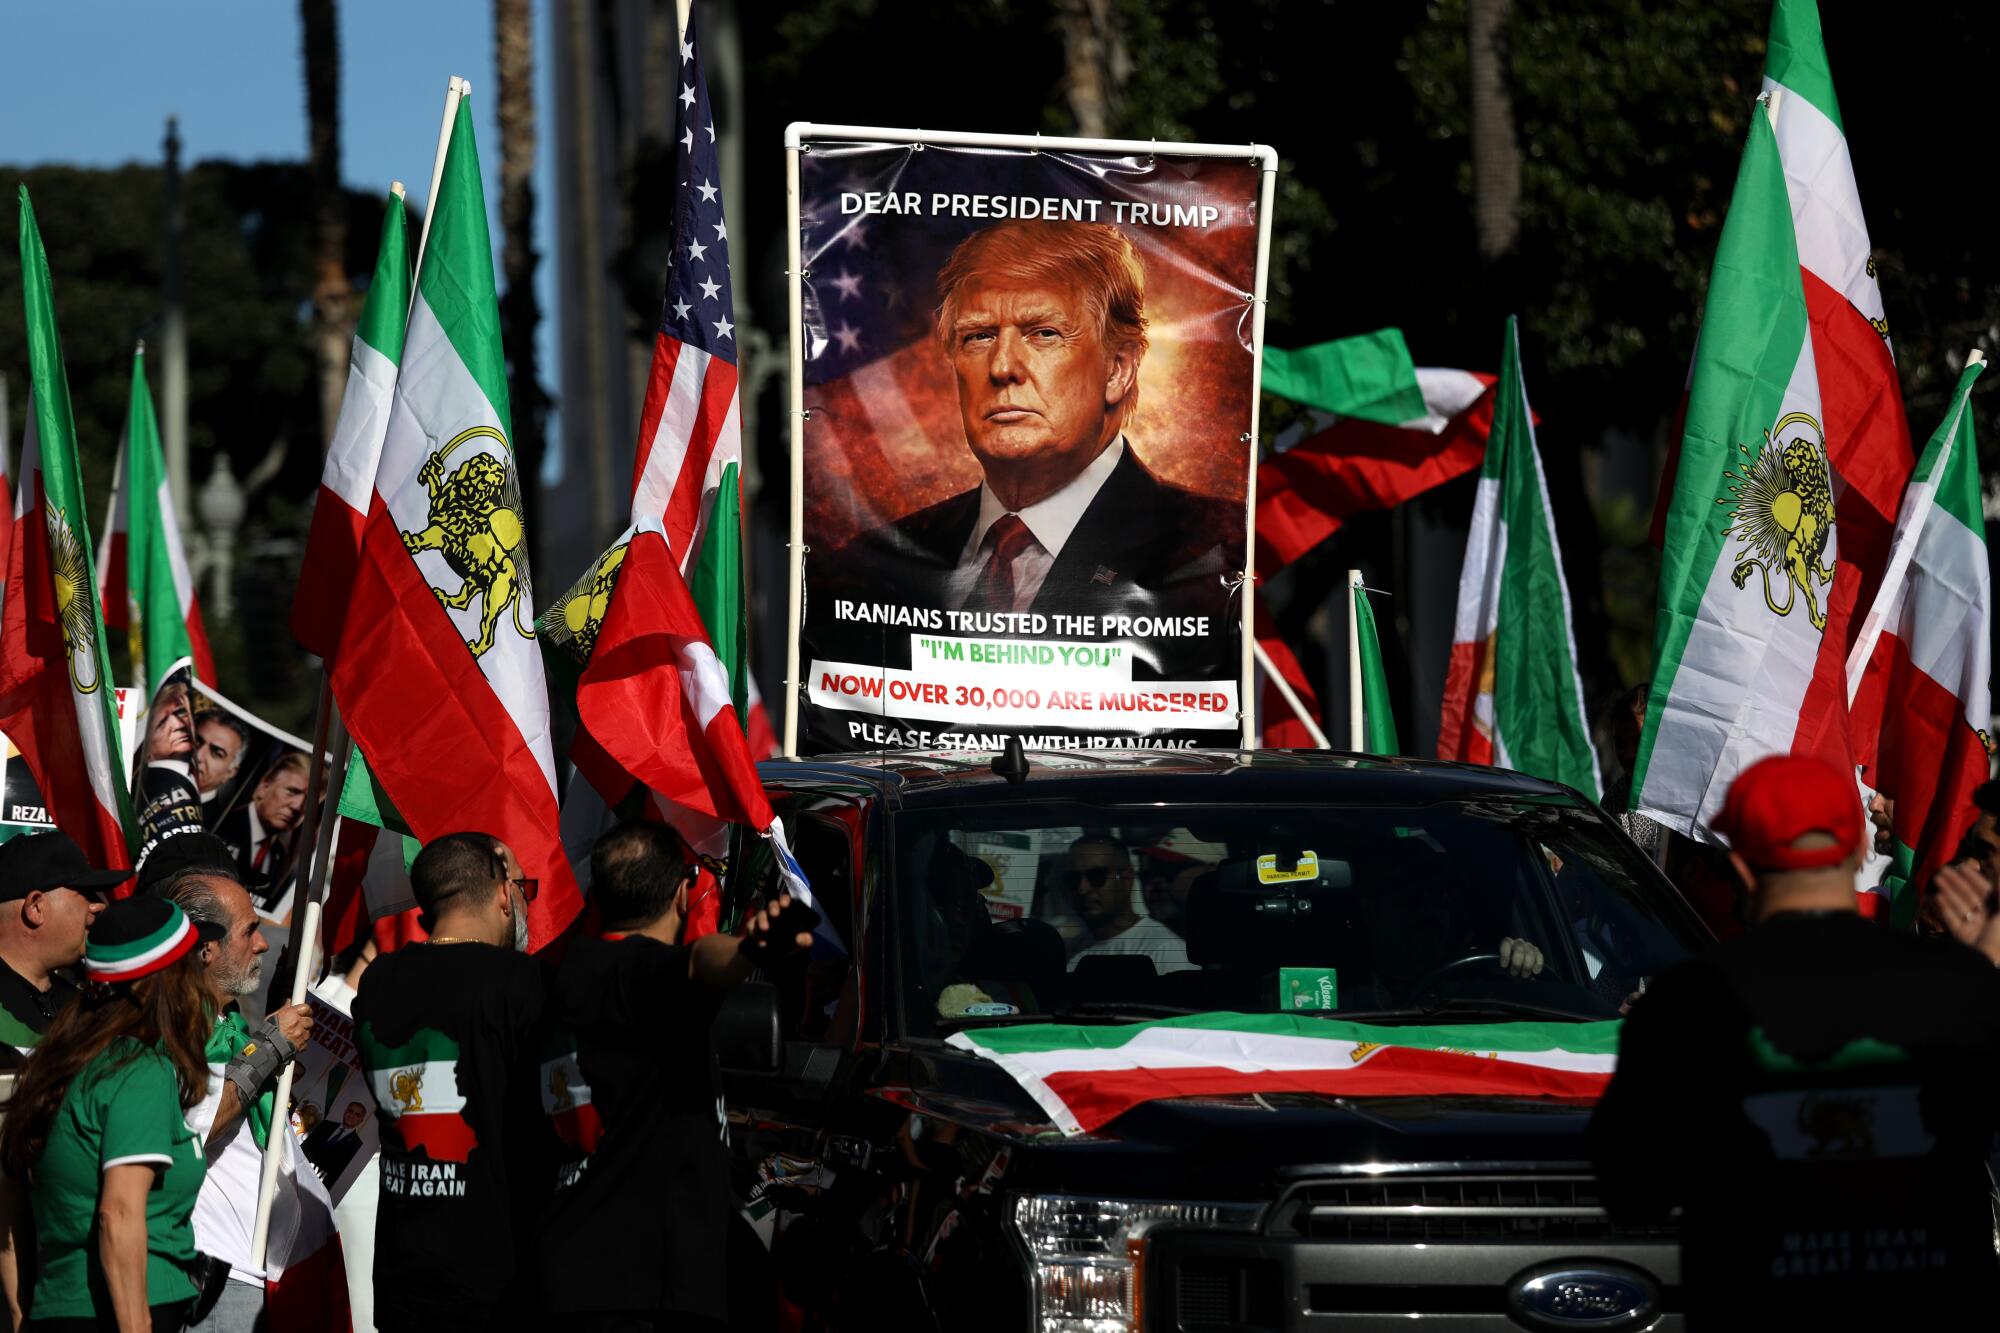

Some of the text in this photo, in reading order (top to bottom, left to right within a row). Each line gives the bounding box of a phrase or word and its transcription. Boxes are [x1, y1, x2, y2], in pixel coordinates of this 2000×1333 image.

[840, 192, 1219, 228] DEAR PRESIDENT TRUMP
[834, 599, 1209, 637] IRANIANS TRUSTED THE PROMISE
[920, 639, 1122, 669] "I'M BEHIND YOU"
[821, 672, 1229, 713] NOW OVER 30,000 ARE MURDERED
[848, 721, 932, 749] PLEASE
[1017, 734, 1080, 750] WITH
[12, 805, 46, 822] REZA
[309, 1023, 354, 1059] REAT
[411, 1162, 456, 1180] IRAN
[409, 1180, 466, 1197] AGAIN
[1782, 1227, 1928, 1249] MAKE IRAN
[1770, 1247, 1948, 1275] GREAT AGAIN
[1552, 1282, 1622, 1313] Ford
